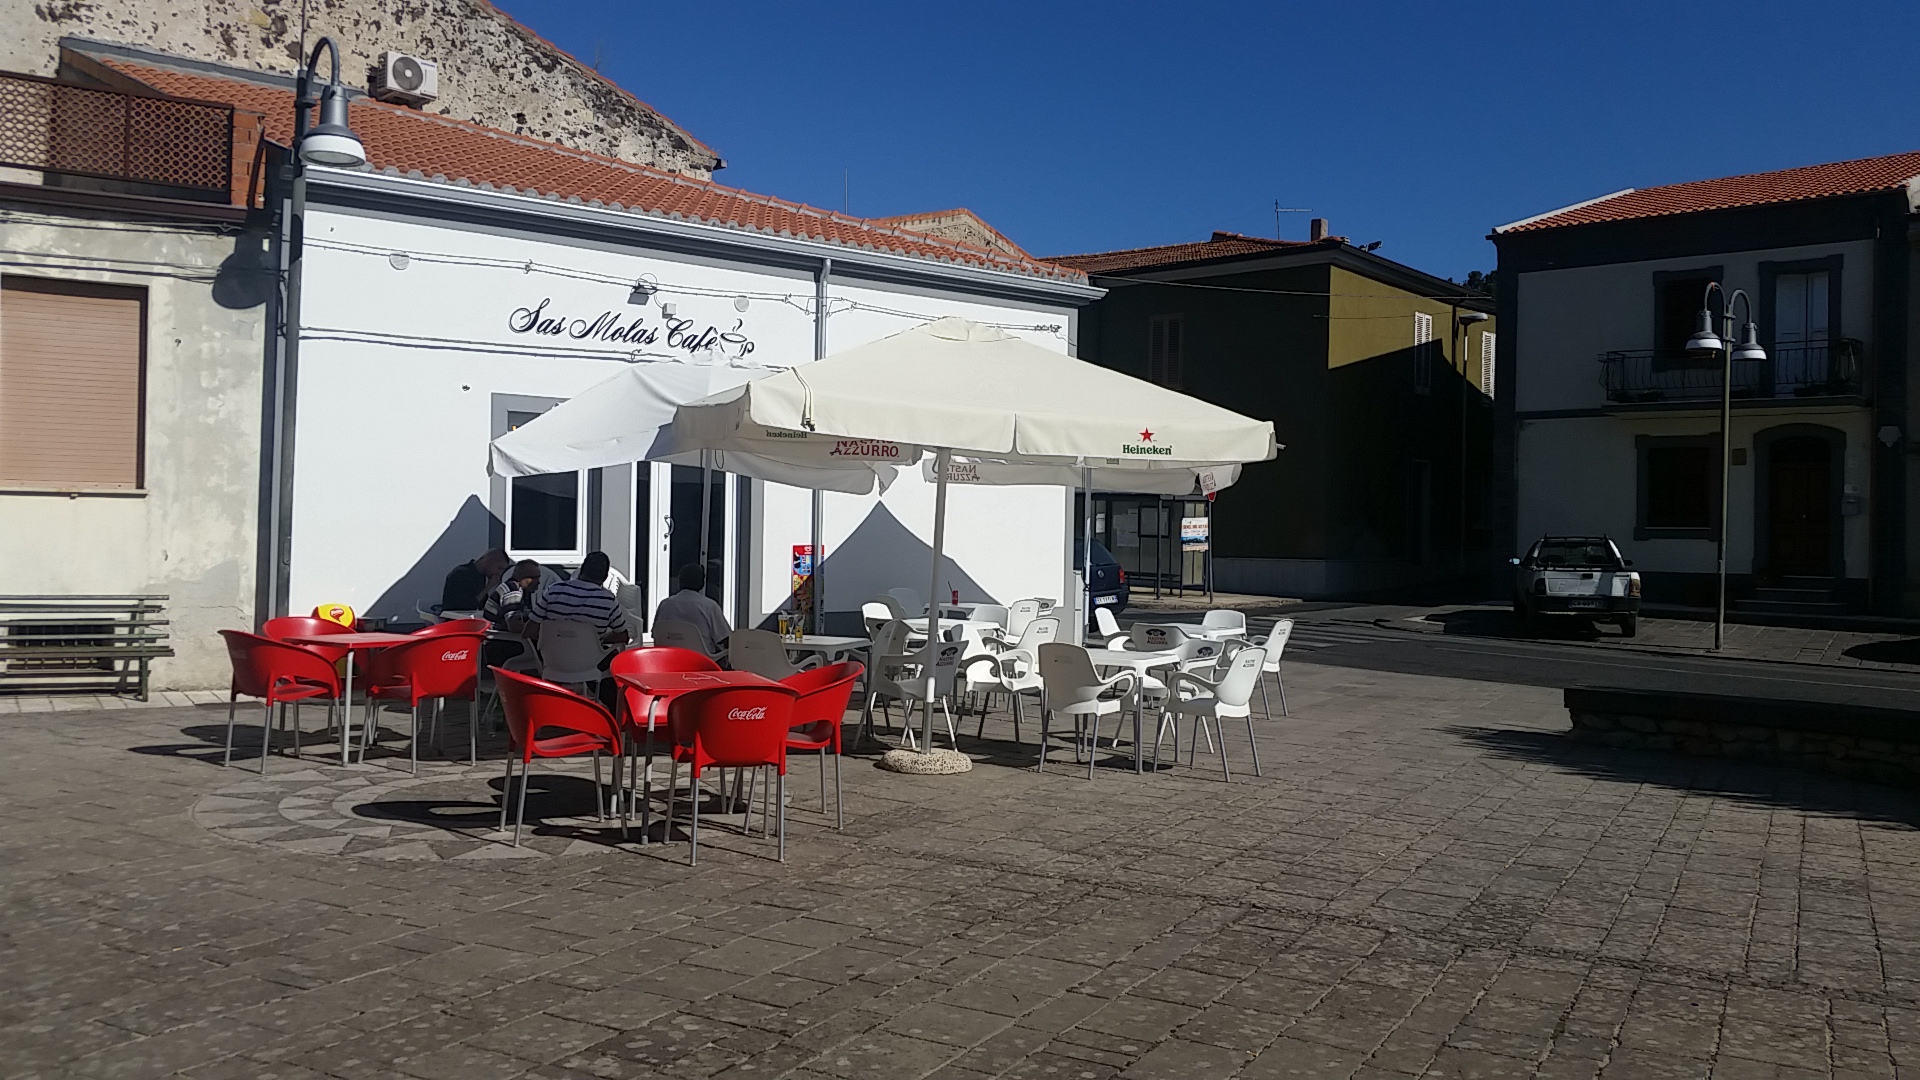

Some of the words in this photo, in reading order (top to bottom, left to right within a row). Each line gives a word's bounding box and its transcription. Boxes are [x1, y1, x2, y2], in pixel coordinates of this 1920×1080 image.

[509, 298, 566, 333] Sas
[569, 311, 659, 345] Molas
[829, 445, 899, 457] AZZURRO
[1122, 444, 1172, 455] Heineken
